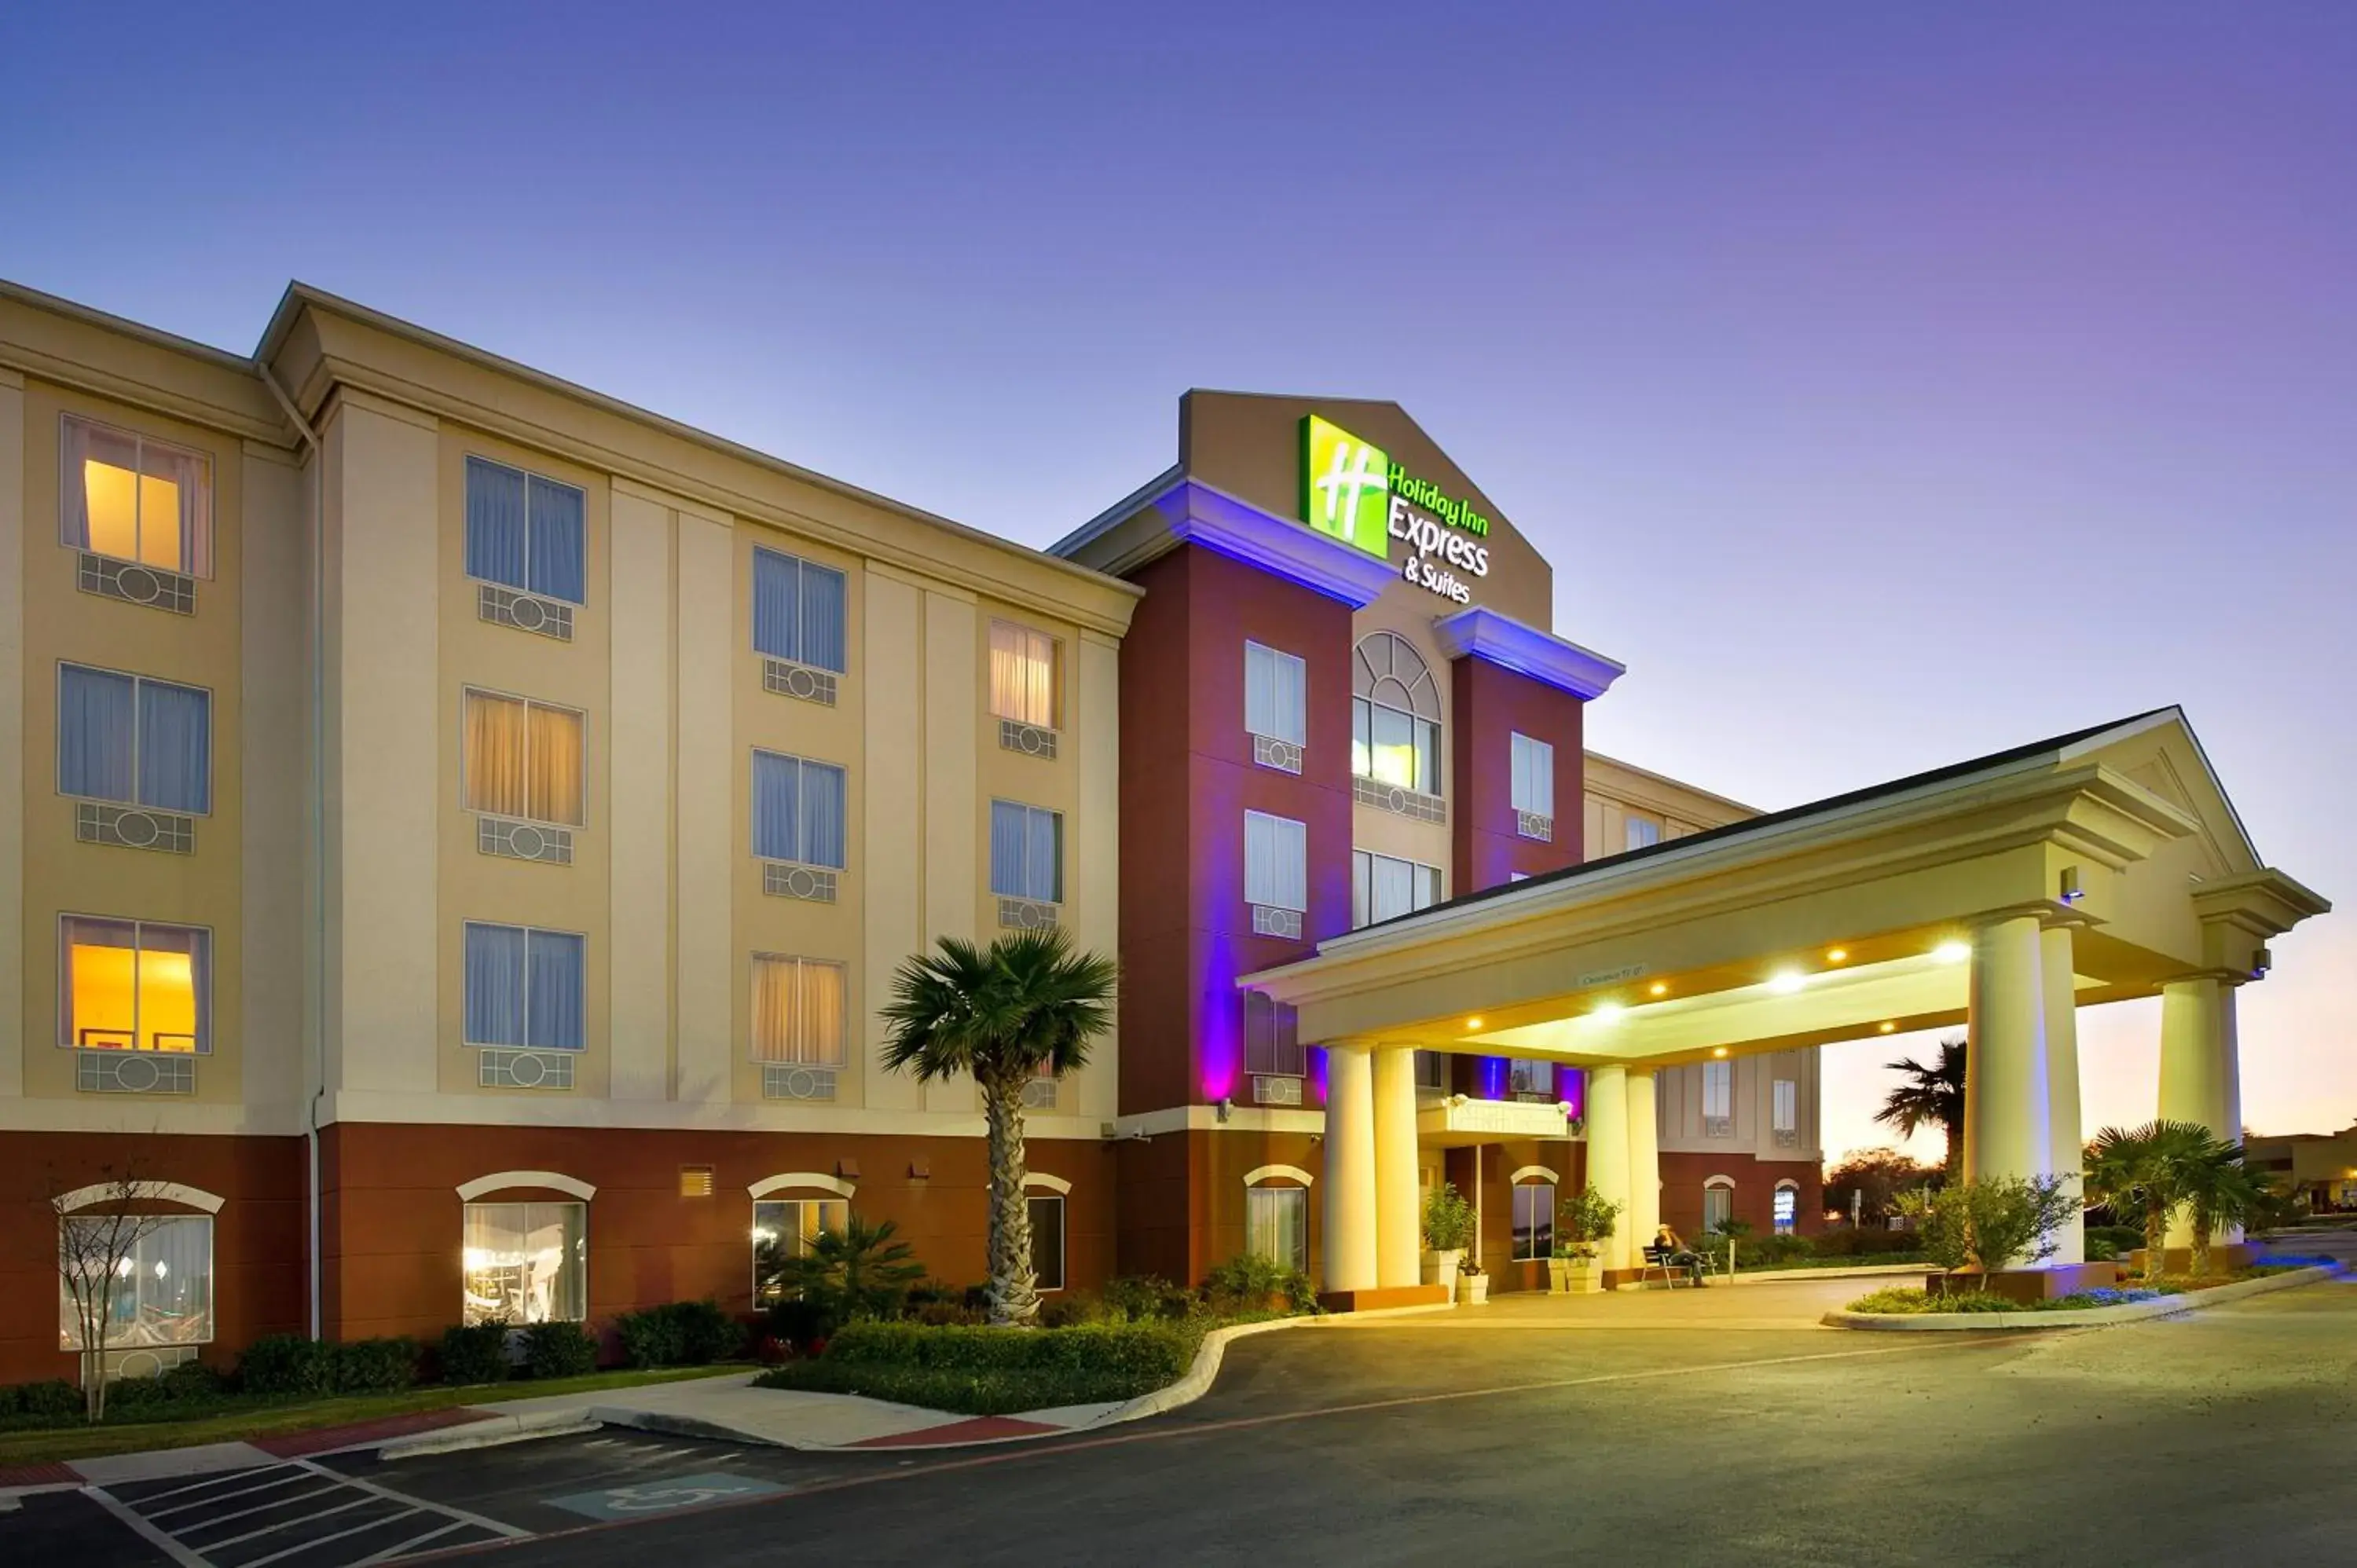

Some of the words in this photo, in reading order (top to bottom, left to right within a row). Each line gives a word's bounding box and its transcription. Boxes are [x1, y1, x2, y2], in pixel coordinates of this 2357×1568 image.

[1388, 463, 1459, 526] Holiday
[1461, 499, 1487, 536] Inn
[1388, 496, 1488, 577] Express
[1405, 555, 1419, 581] &
[1420, 563, 1470, 603] Suites
